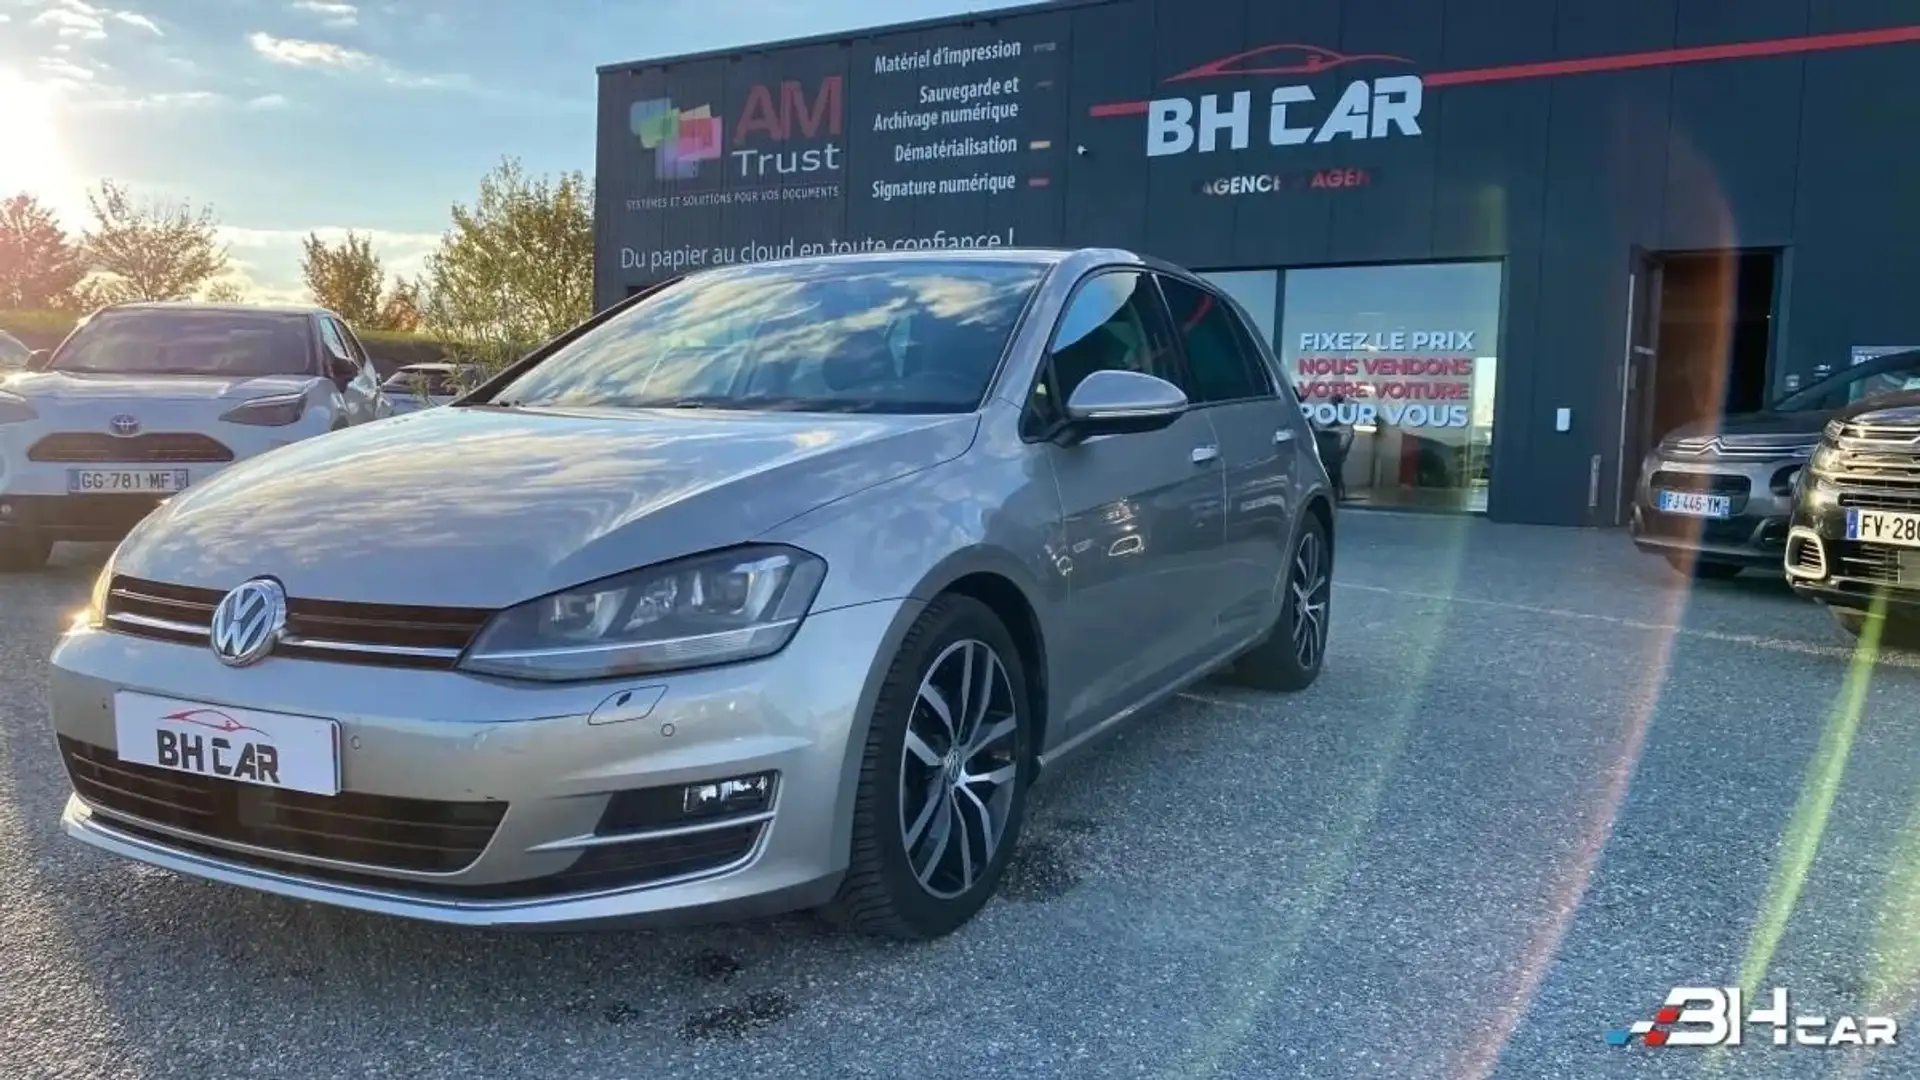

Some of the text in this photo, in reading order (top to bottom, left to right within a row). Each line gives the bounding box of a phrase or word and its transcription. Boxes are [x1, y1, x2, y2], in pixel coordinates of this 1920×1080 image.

[875, 40, 1021, 73] Matériel d'impression
[920, 77, 1020, 103] Sauvegarde et
[733, 76, 842, 144] AM
[873, 101, 1019, 131] Archivage numérique
[1147, 75, 1423, 156] BH CAR
[731, 143, 840, 176] Trust
[895, 135, 1017, 162] Dématérialisation
[670, 196, 680, 207] ET
[683, 191, 732, 206] SOLUTIONS
[734, 191, 759, 204] POUR
[761, 189, 779, 201] VOS
[782, 185, 839, 200] DOCUMENTS
[872, 173, 1016, 201] Signature numérique
[621, 247, 645, 268] Du
[651, 244, 708, 272] papier
[712, 246, 735, 264] au
[741, 236, 794, 264] cloud
[800, 241, 824, 257] en
[830, 237, 886, 253] toute
[893, 230, 1000, 250] confiance
[1300, 331, 1475, 351] FIXEZ LE PRIX
[1298, 357, 1473, 377] NOUS VENDONS
[1298, 382, 1469, 399] VOTRE VOITURE
[1300, 404, 1469, 428] POUR VOUS
[157, 729, 281, 784] BH CAR
